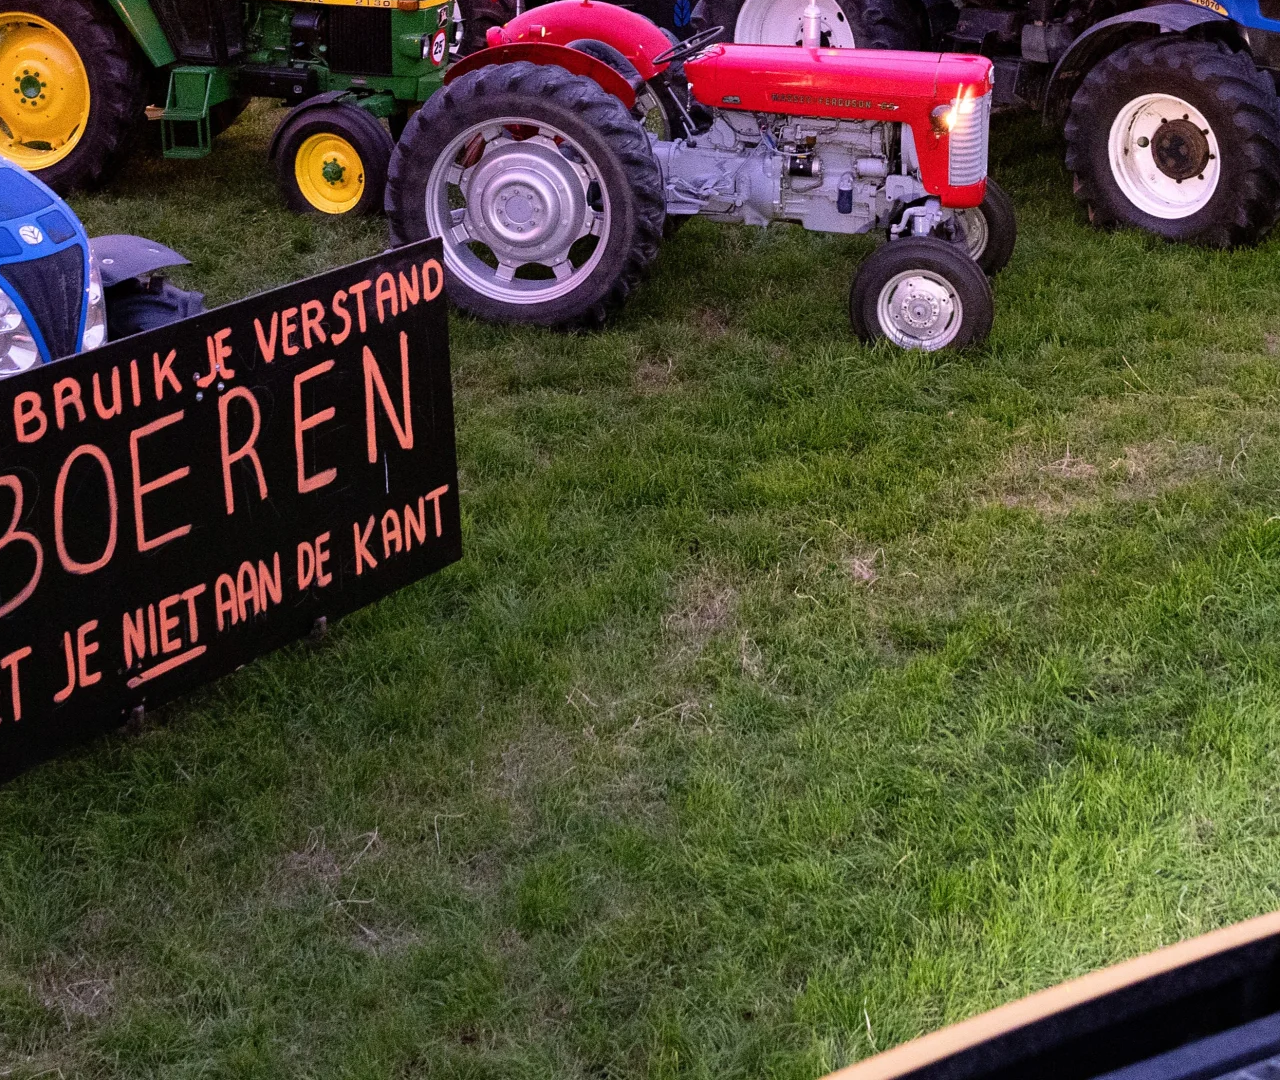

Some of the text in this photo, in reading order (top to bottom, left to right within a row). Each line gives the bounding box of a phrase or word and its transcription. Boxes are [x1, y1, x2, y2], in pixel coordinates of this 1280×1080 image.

[433, 39, 445, 55] 25
[195, 327, 232, 388] JE
[254, 259, 445, 363] VERSTAND
[53, 619, 102, 703] JE
[122, 583, 207, 666] NIET
[214, 552, 283, 632] AAN
[297, 531, 332, 592] DE
[355, 484, 450, 576] KANT
